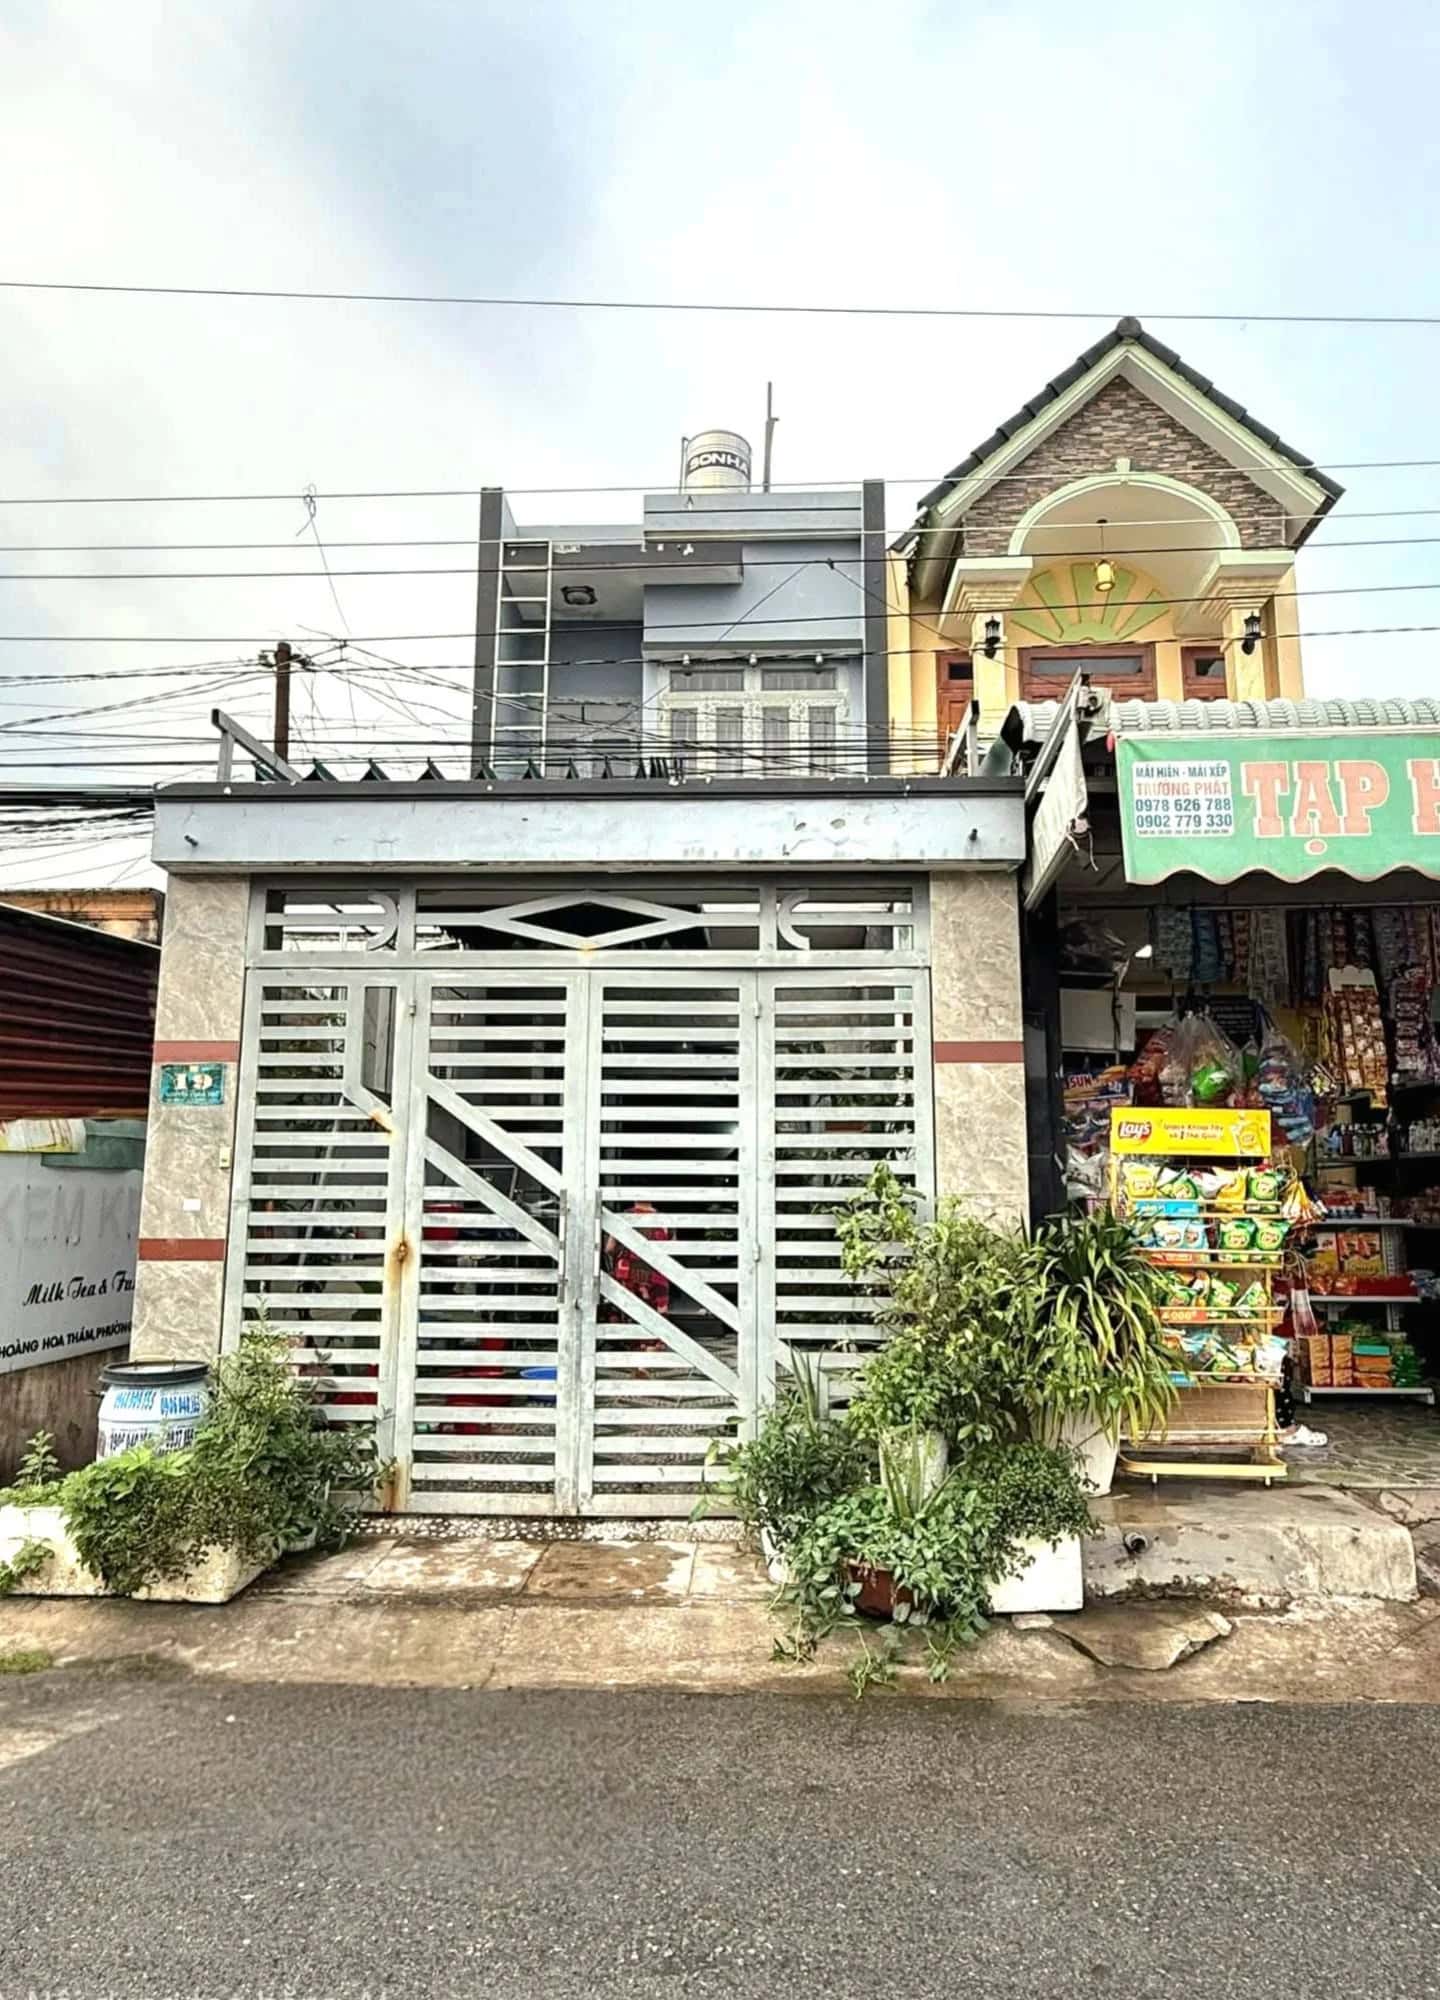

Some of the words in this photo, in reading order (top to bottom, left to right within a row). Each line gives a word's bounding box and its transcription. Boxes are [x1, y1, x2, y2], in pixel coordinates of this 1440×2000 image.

[1136, 798, 1170, 812] 0978
[1174, 798, 1201, 812] 626
[1205, 797, 1231, 811] 788
[1241, 760, 1390, 855] TẠP
[1136, 814, 1170, 828] 0902
[1175, 814, 1202, 828] 779
[1206, 814, 1232, 828] 330
[22, 1282, 64, 1306] Milk
[67, 1275, 96, 1300] Tea
[0, 1338, 39, 1359] HOÀNG
[42, 1335, 65, 1350] HOA
